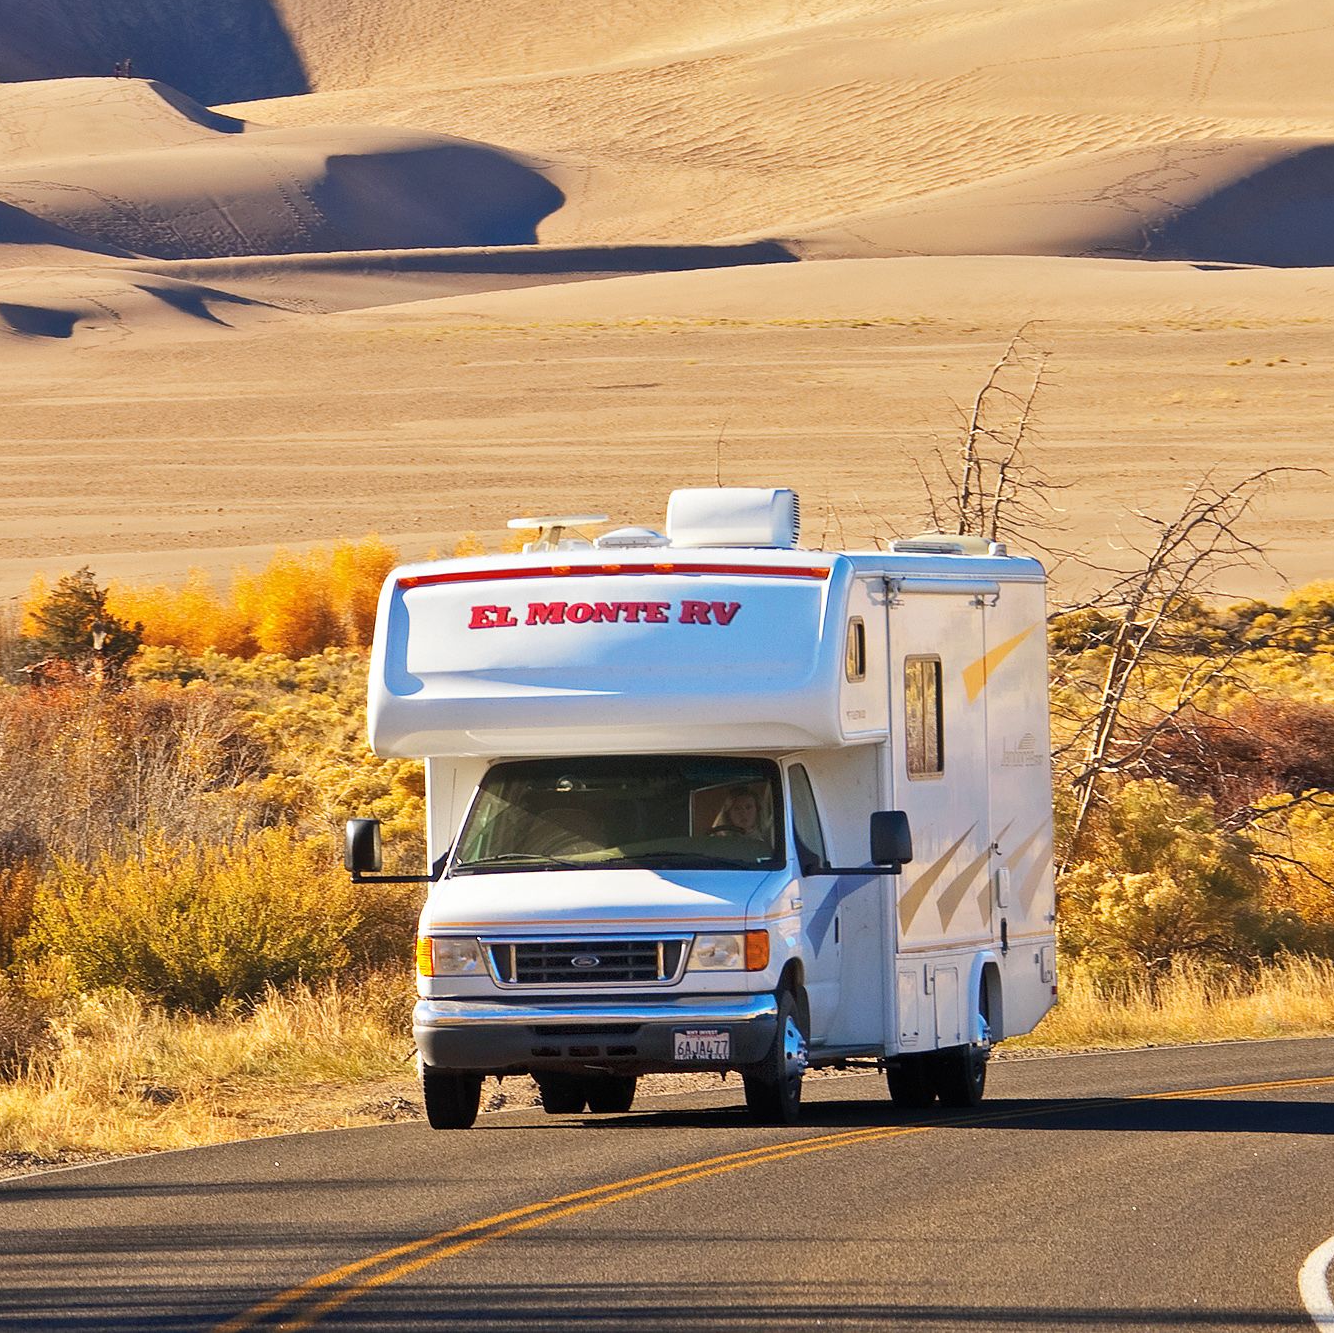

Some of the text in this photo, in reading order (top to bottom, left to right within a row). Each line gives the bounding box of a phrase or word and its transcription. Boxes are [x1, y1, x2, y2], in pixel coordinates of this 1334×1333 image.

[468, 600, 742, 629] EL MONTE RV
[678, 1041, 728, 1055] 6AJA477
